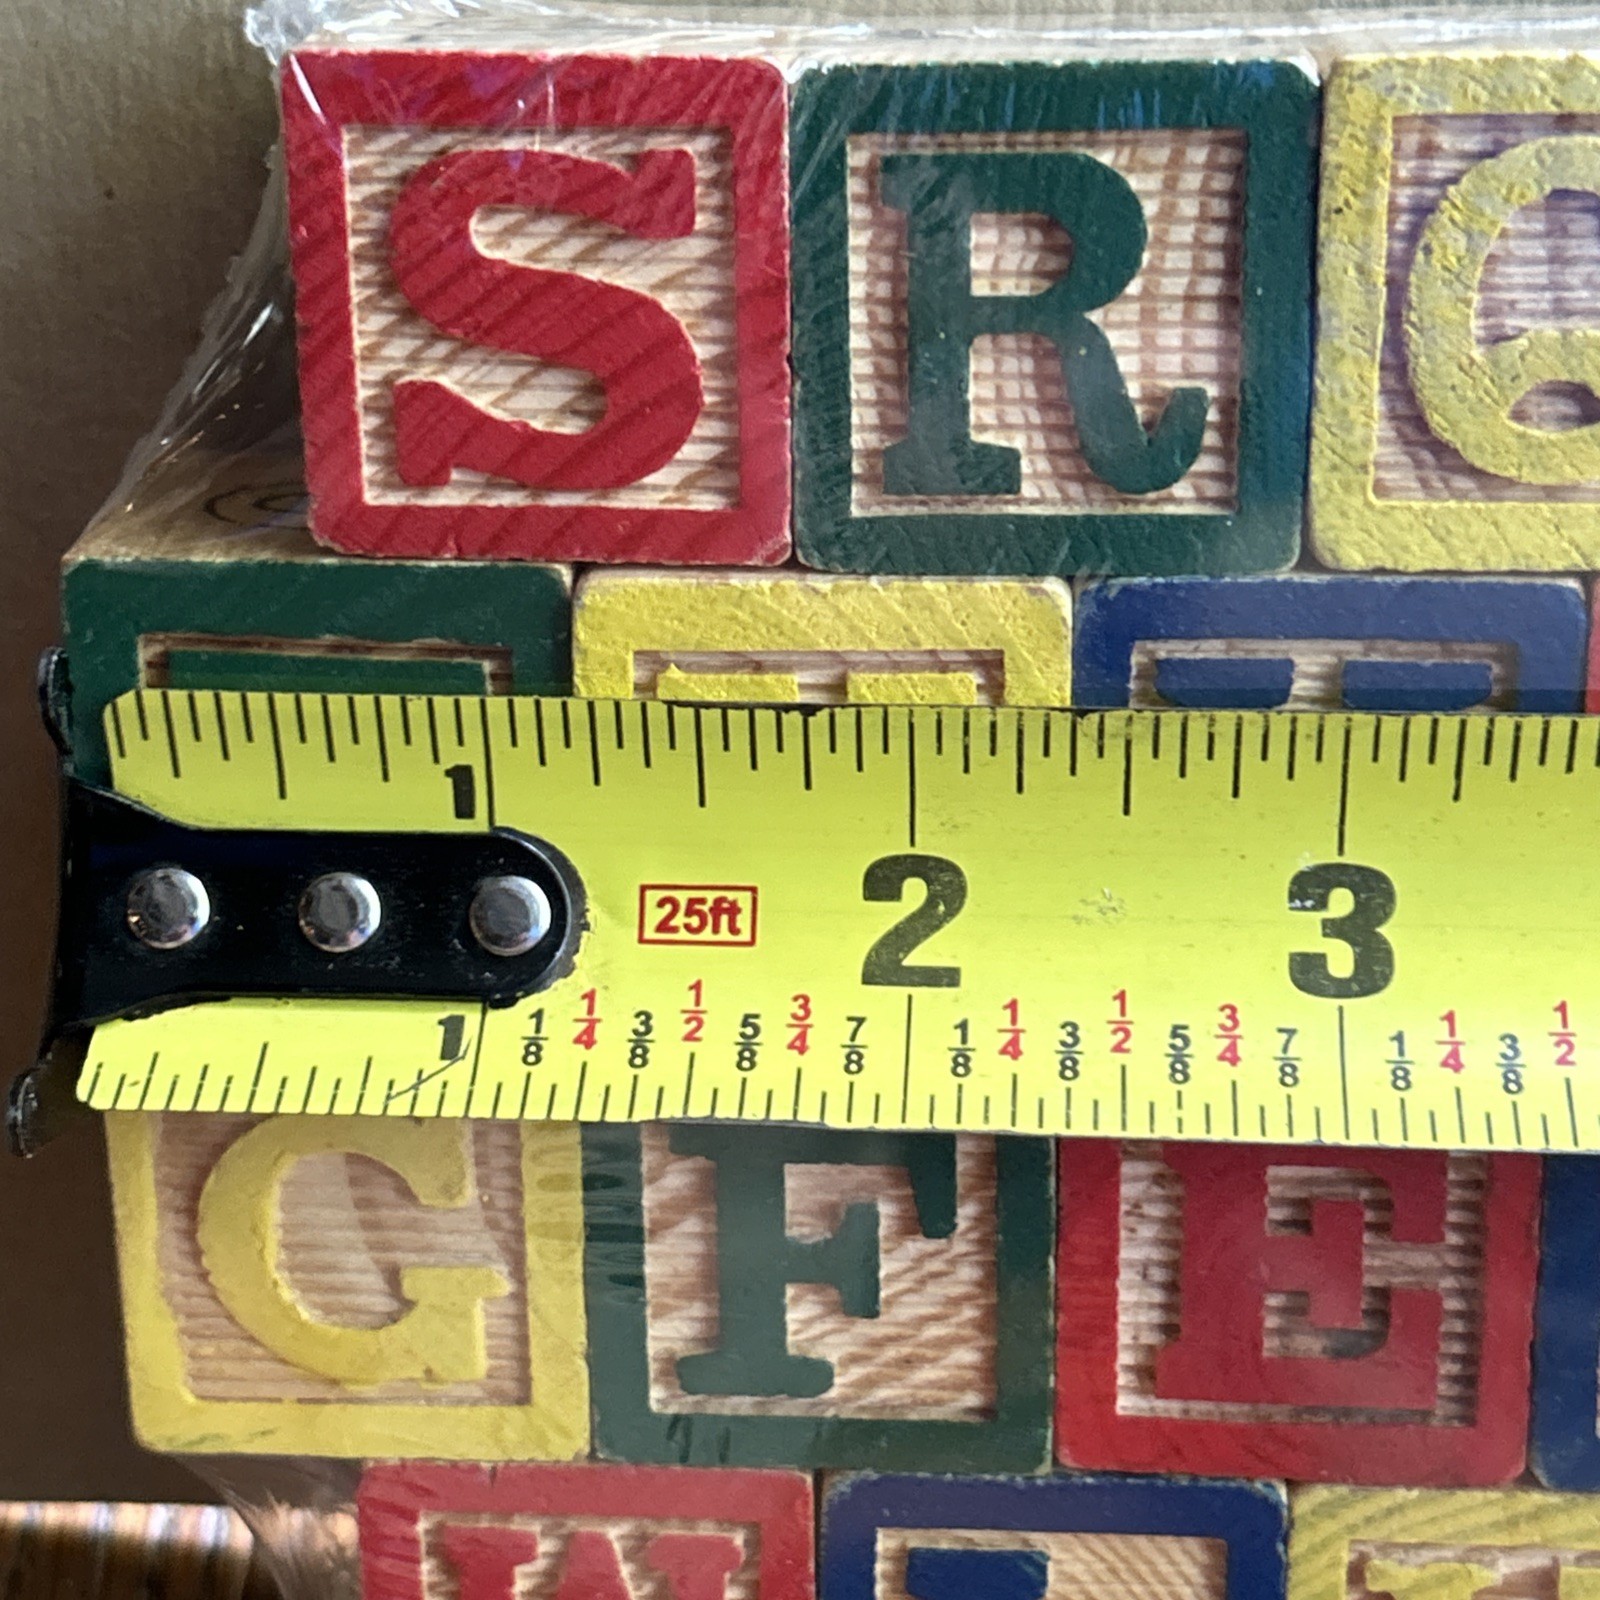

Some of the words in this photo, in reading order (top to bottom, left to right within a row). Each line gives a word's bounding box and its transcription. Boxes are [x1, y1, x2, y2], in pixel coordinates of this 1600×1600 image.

[388, 148, 704, 490] S
[880, 152, 1210, 494] R
[444, 765, 475, 819] 1
[655, 895, 742, 936] 25ft
[862, 854, 966, 987] 2
[1289, 863, 1394, 998] 3
[438, 1016, 464, 1062] 1
[199, 1117, 512, 1384] G
[667, 1122, 958, 1397] F
[1155, 1140, 1448, 1410] E
